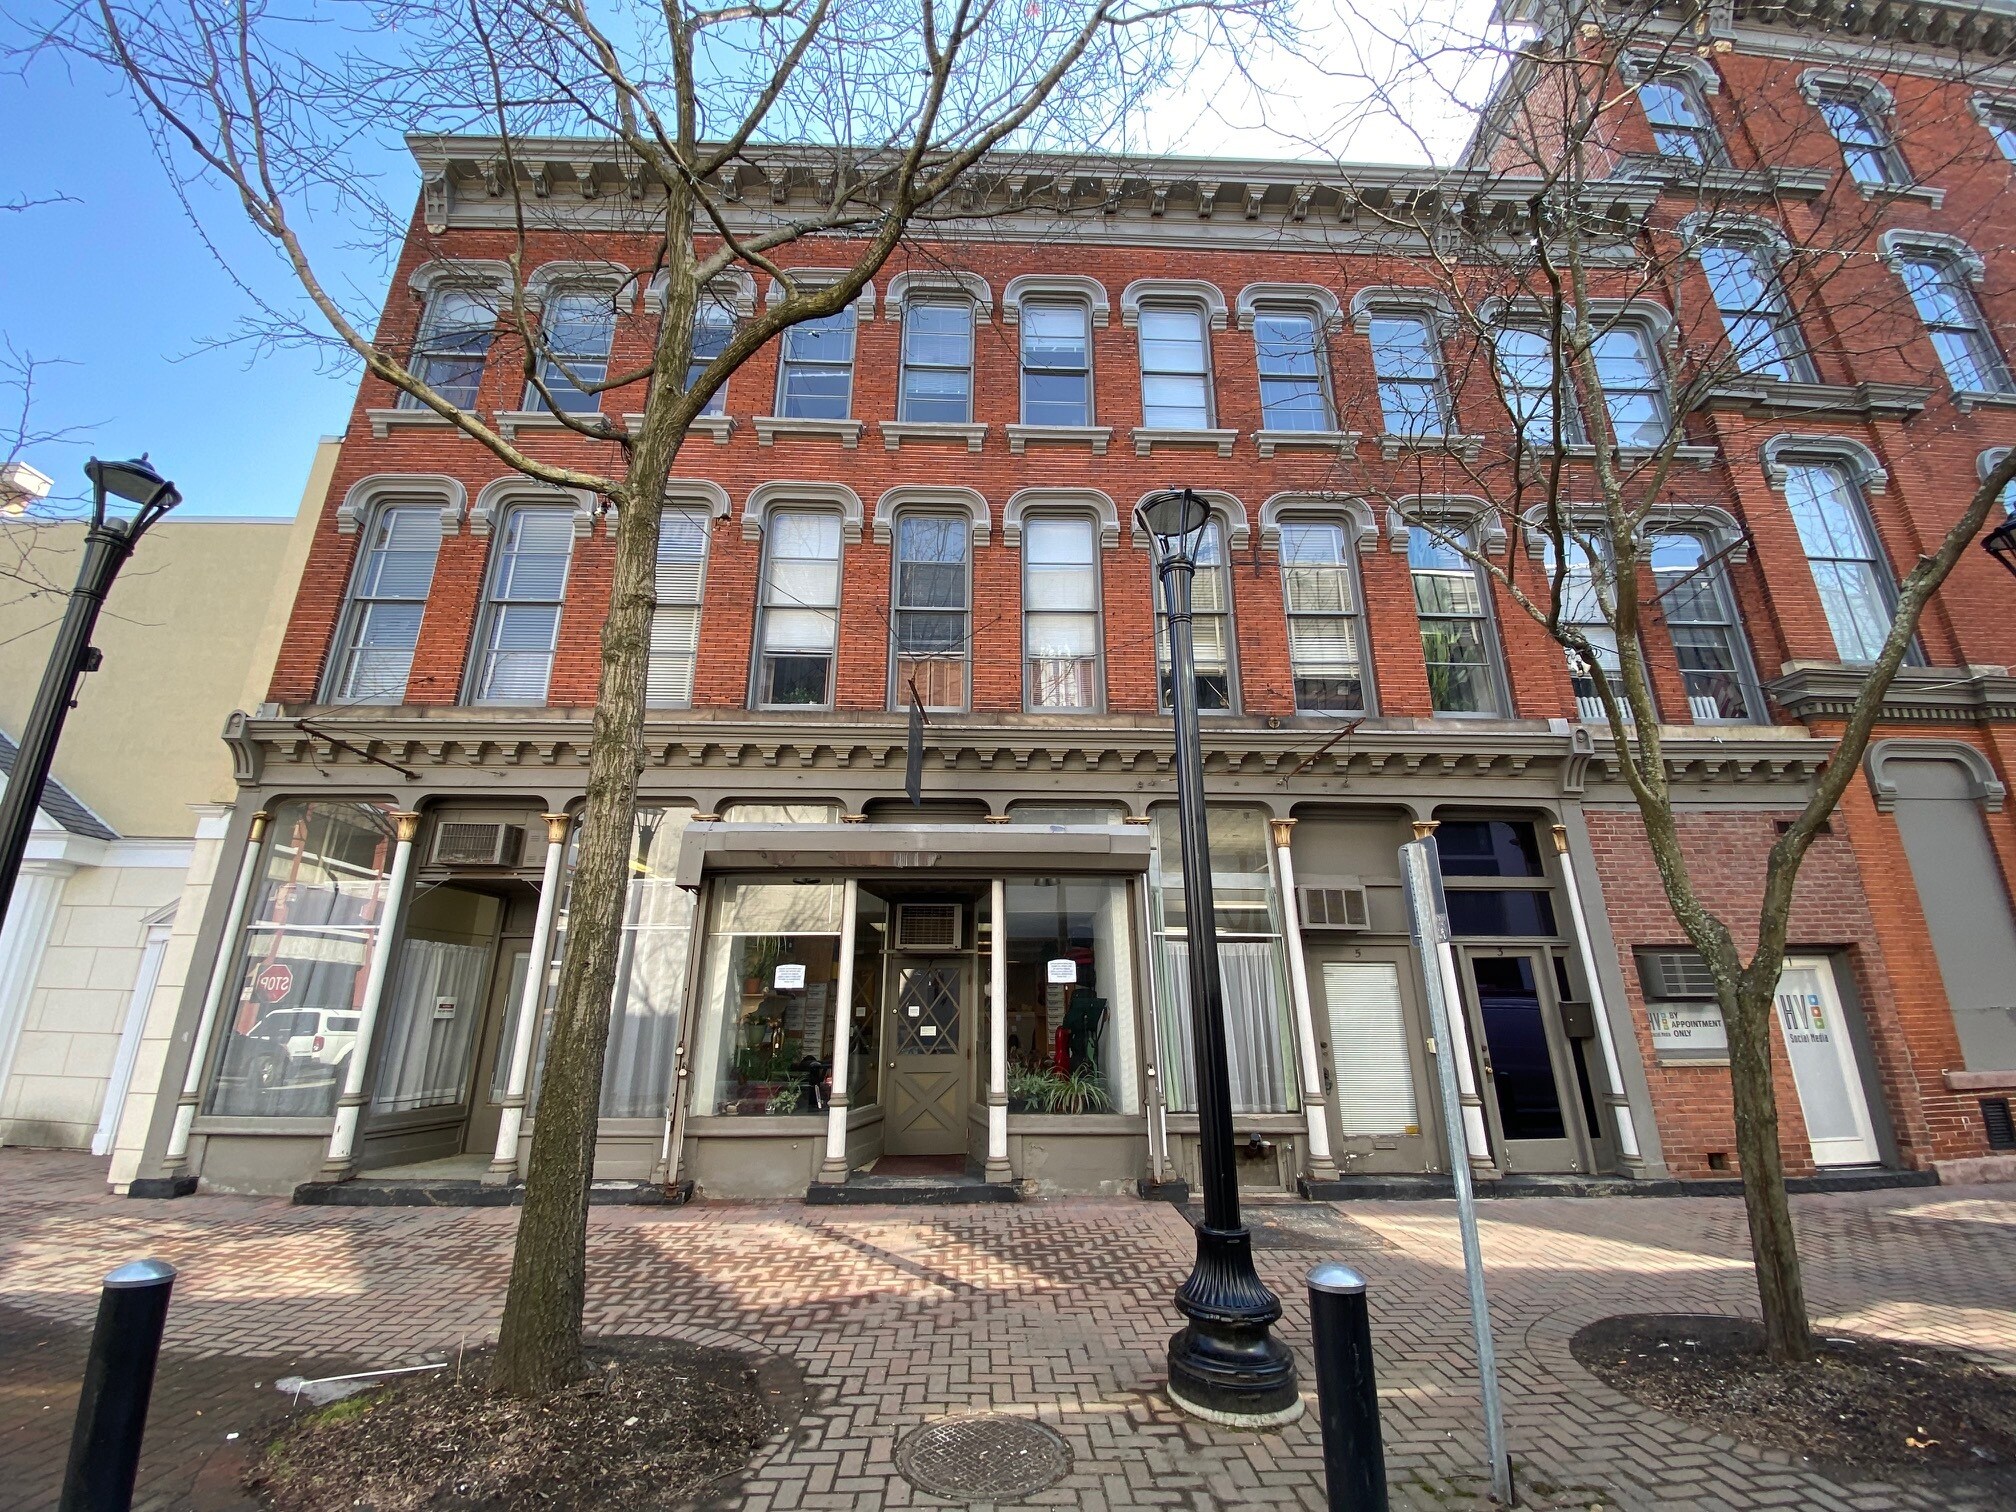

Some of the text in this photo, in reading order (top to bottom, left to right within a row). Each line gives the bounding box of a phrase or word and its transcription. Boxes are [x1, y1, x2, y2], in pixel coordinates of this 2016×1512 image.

[1355, 948, 1361, 958] 5
[1497, 946, 1504, 956] 3
[1780, 995, 1809, 1029] HV
[1671, 1020, 1721, 1028] APPOINTMENT
[1673, 1029, 1691, 1037] ONLY
[1789, 1033, 1829, 1043] Social Media
